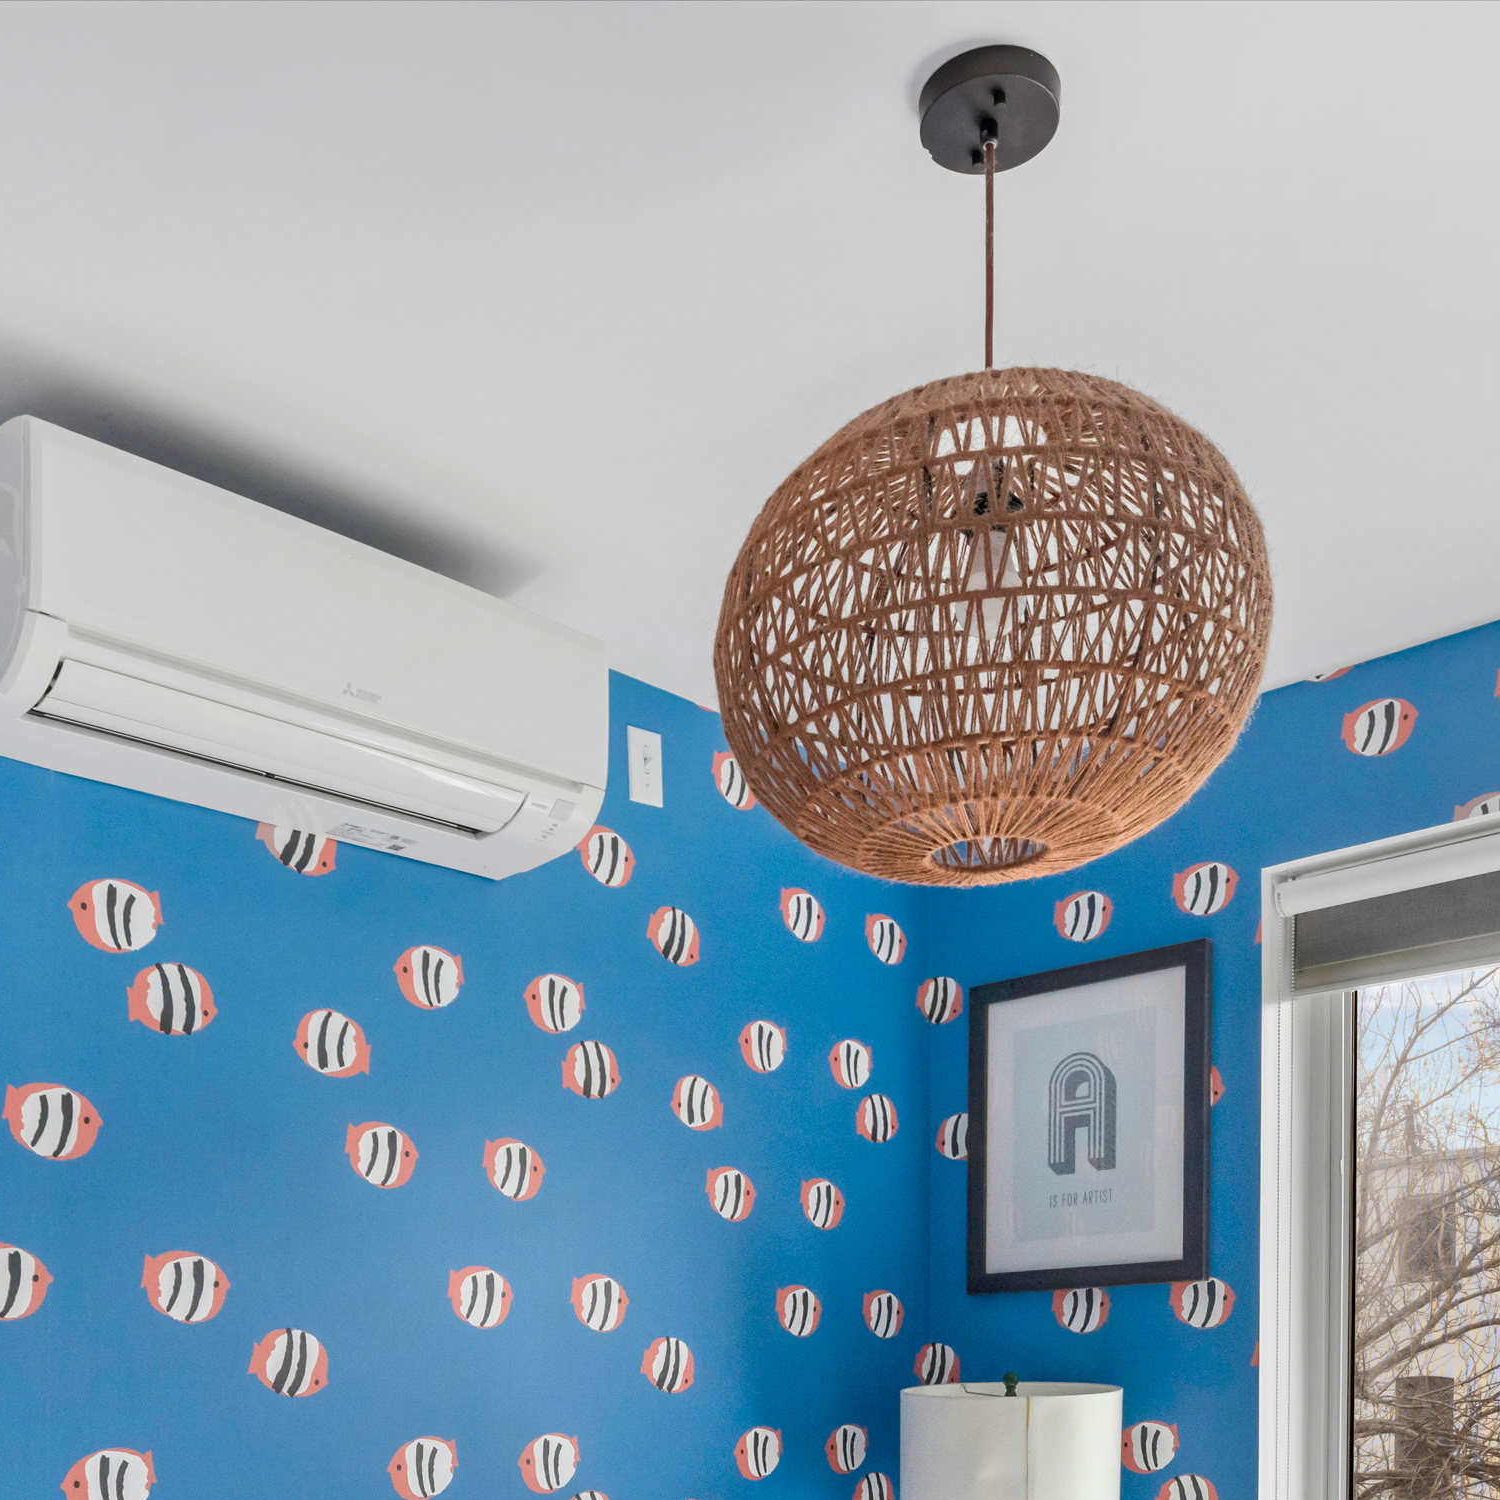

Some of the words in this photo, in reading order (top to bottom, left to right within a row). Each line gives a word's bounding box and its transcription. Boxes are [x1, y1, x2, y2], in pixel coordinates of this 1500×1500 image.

[1048, 1051, 1117, 1176] A
[1049, 1194, 1058, 1208] IS
[1061, 1192, 1078, 1207] FOR
[1082, 1188, 1114, 1205] ARTIST
